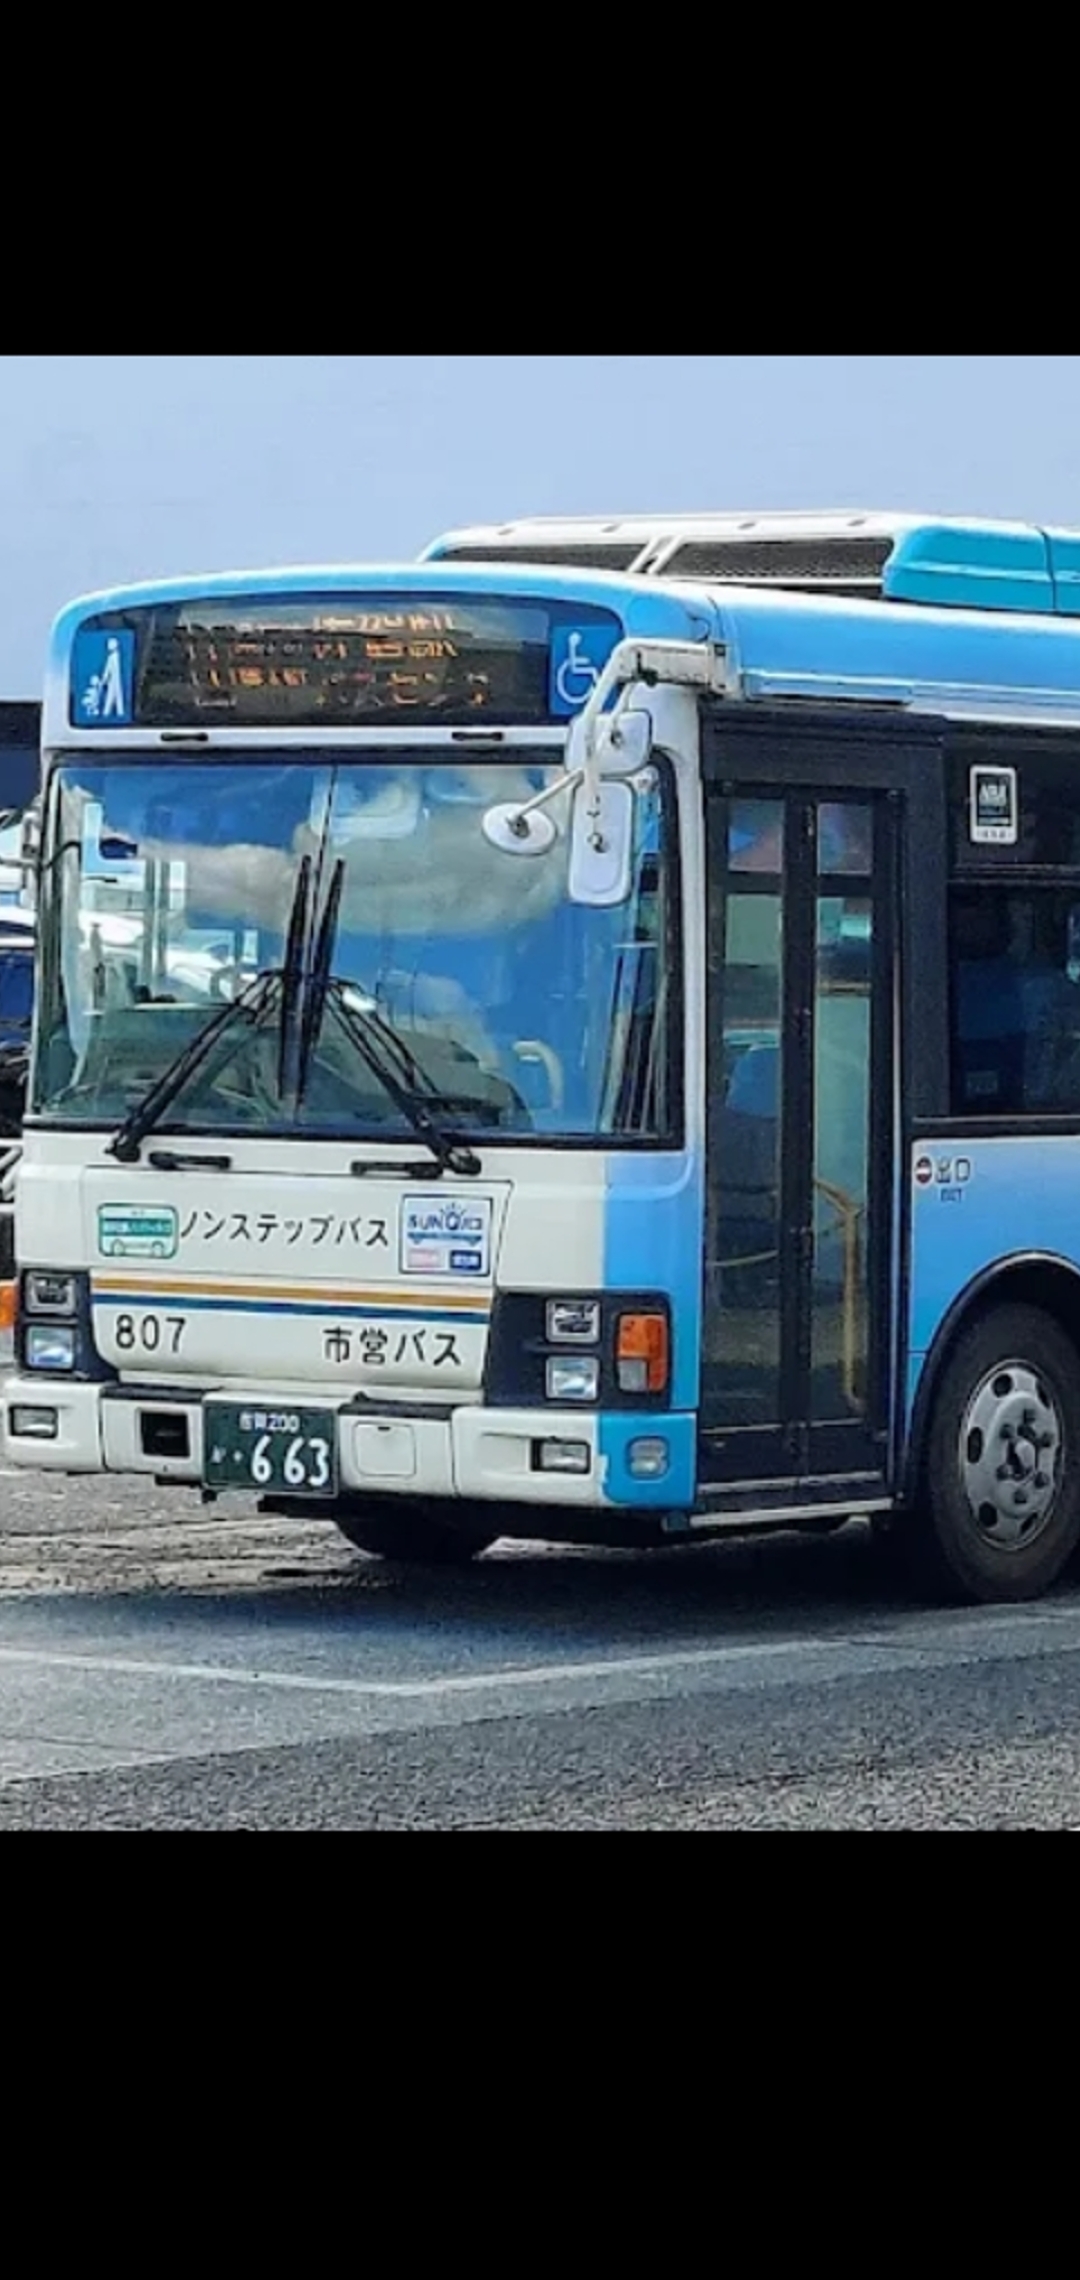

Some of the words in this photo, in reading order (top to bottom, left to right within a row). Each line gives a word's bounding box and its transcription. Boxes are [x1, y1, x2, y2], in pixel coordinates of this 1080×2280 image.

[935, 1156, 971, 1184] 出口
[180, 1210, 389, 1247] ノンステップバス
[115, 1314, 186, 1353] 807
[322, 1327, 461, 1366] 市営バス
[252, 1434, 329, 1486] 663
